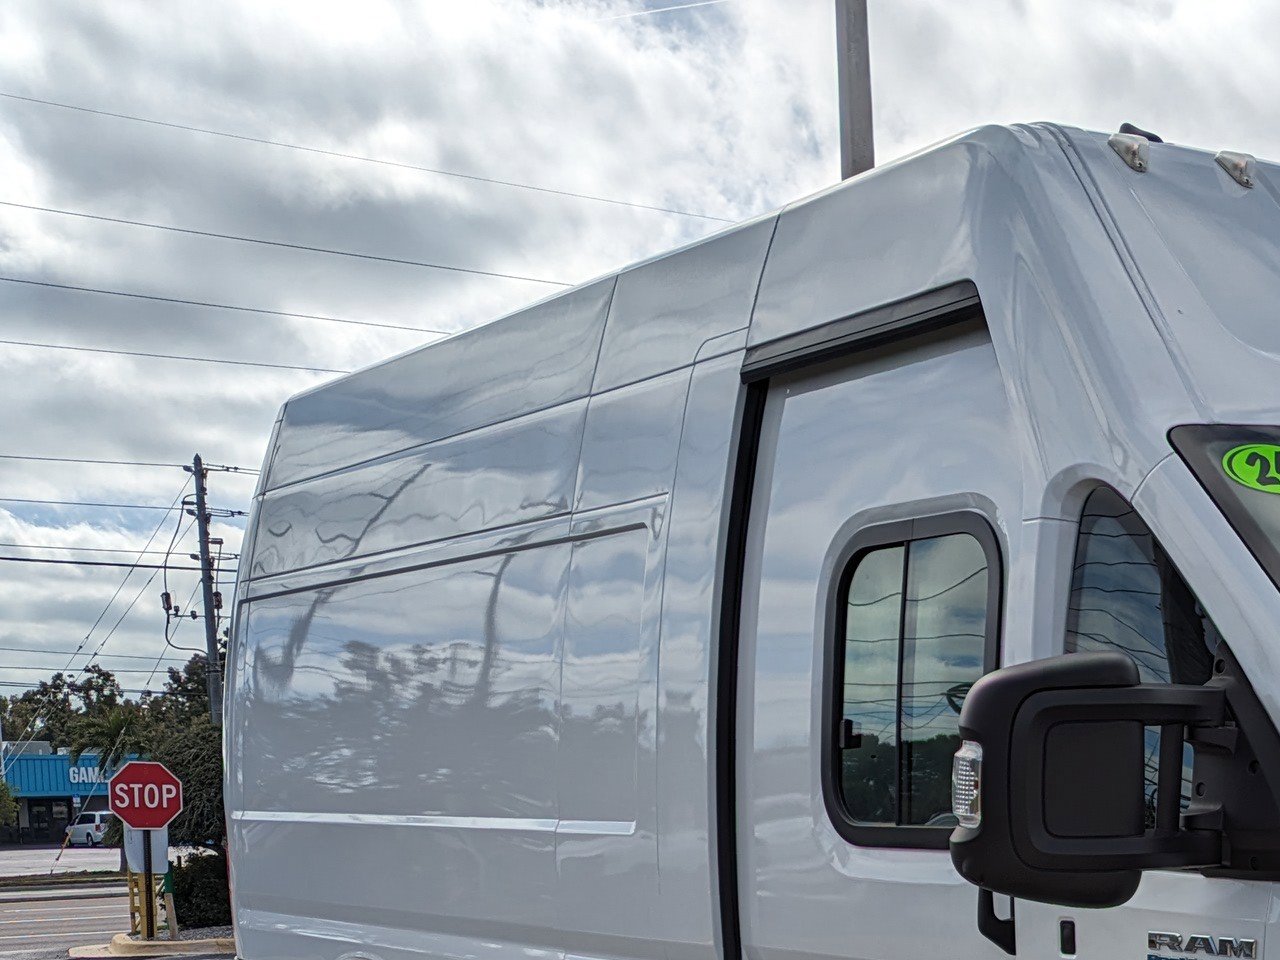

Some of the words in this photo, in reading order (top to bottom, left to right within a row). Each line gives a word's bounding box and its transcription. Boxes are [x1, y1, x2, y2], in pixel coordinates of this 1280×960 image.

[69, 766, 110, 783] GAM
[114, 783, 177, 809] STOP
[1147, 930, 1257, 959] RAM
